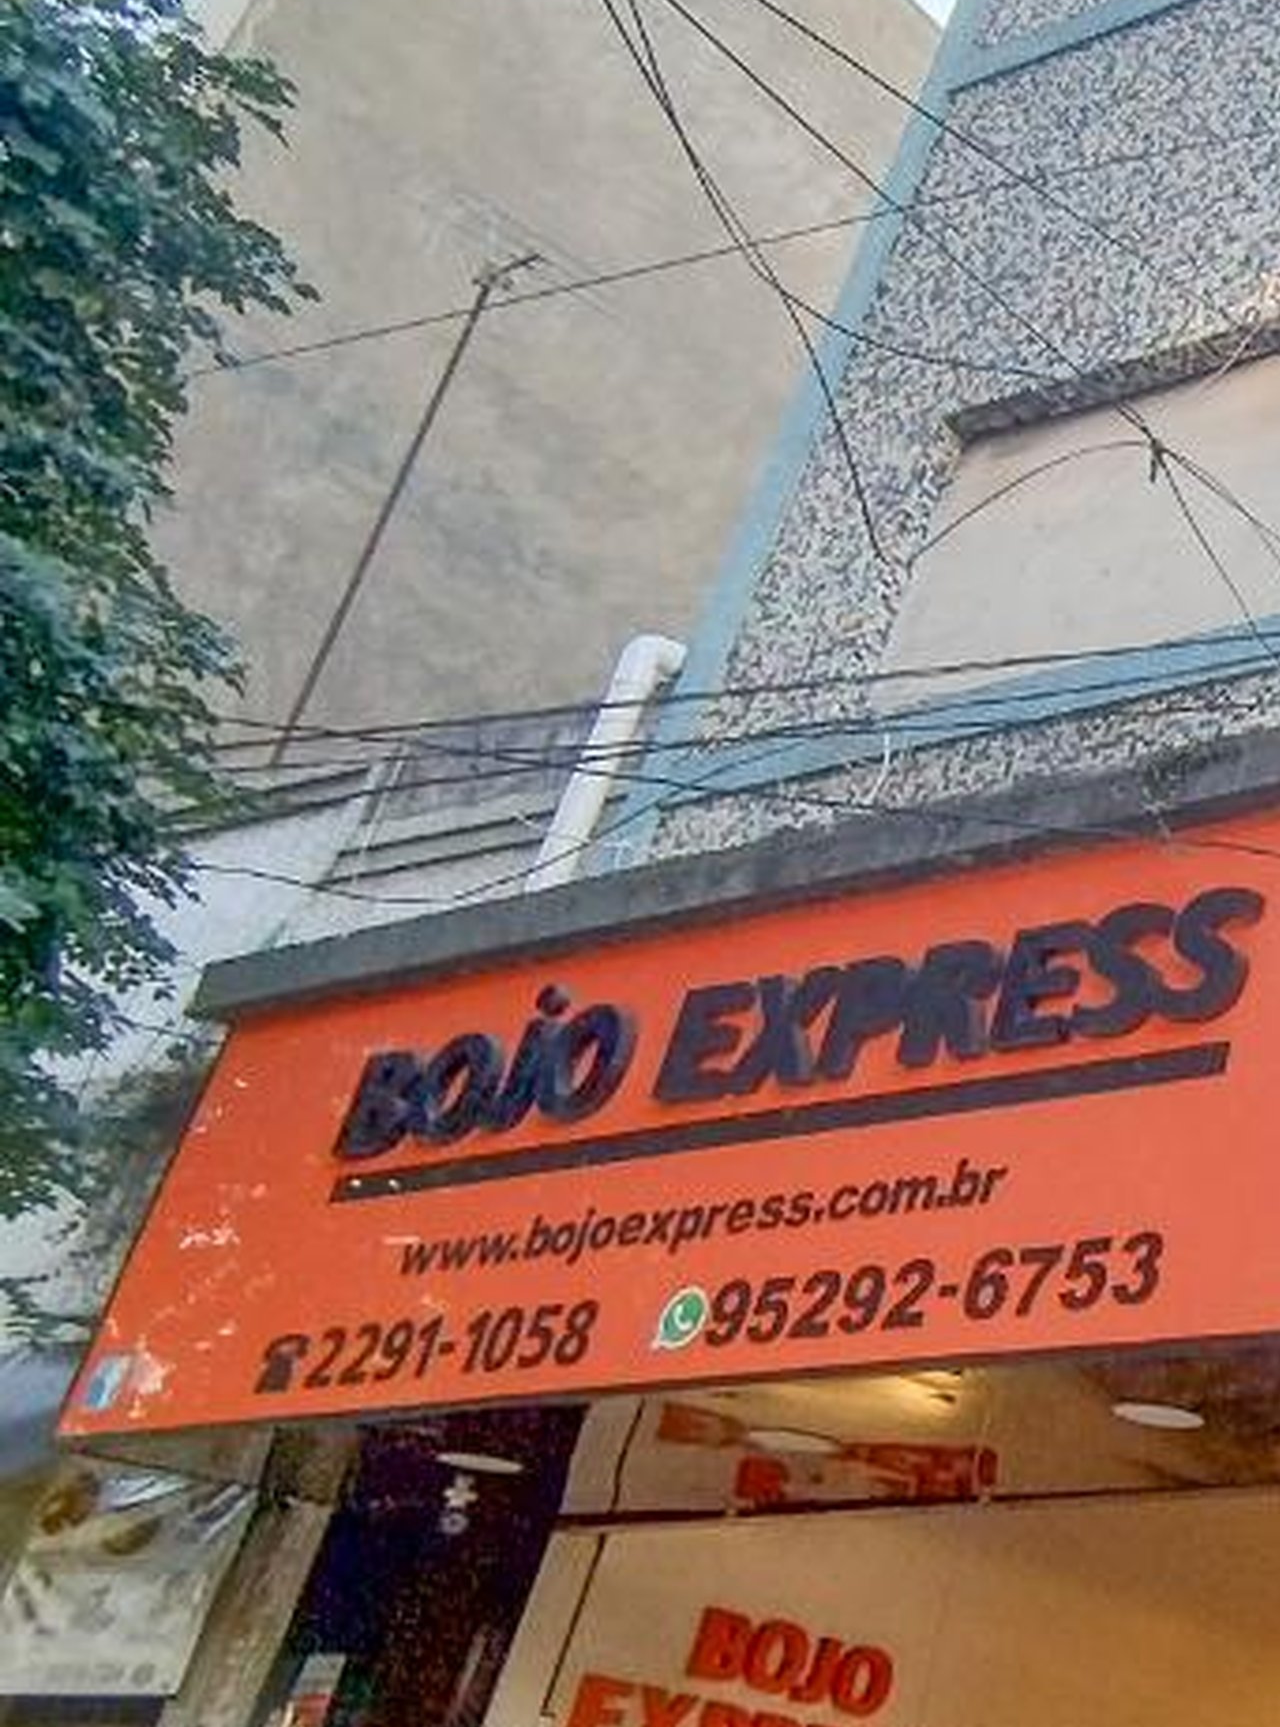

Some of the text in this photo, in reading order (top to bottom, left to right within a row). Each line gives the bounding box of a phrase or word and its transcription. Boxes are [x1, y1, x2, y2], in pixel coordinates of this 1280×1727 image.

[332, 887, 1266, 1159] BOJO EXPRESS
[398, 1156, 1008, 1275] www.bojoexpress.com.br
[304, 1230, 1164, 1389] 2291-1058 95292-6753
[685, 1606, 895, 1718] BOJO
